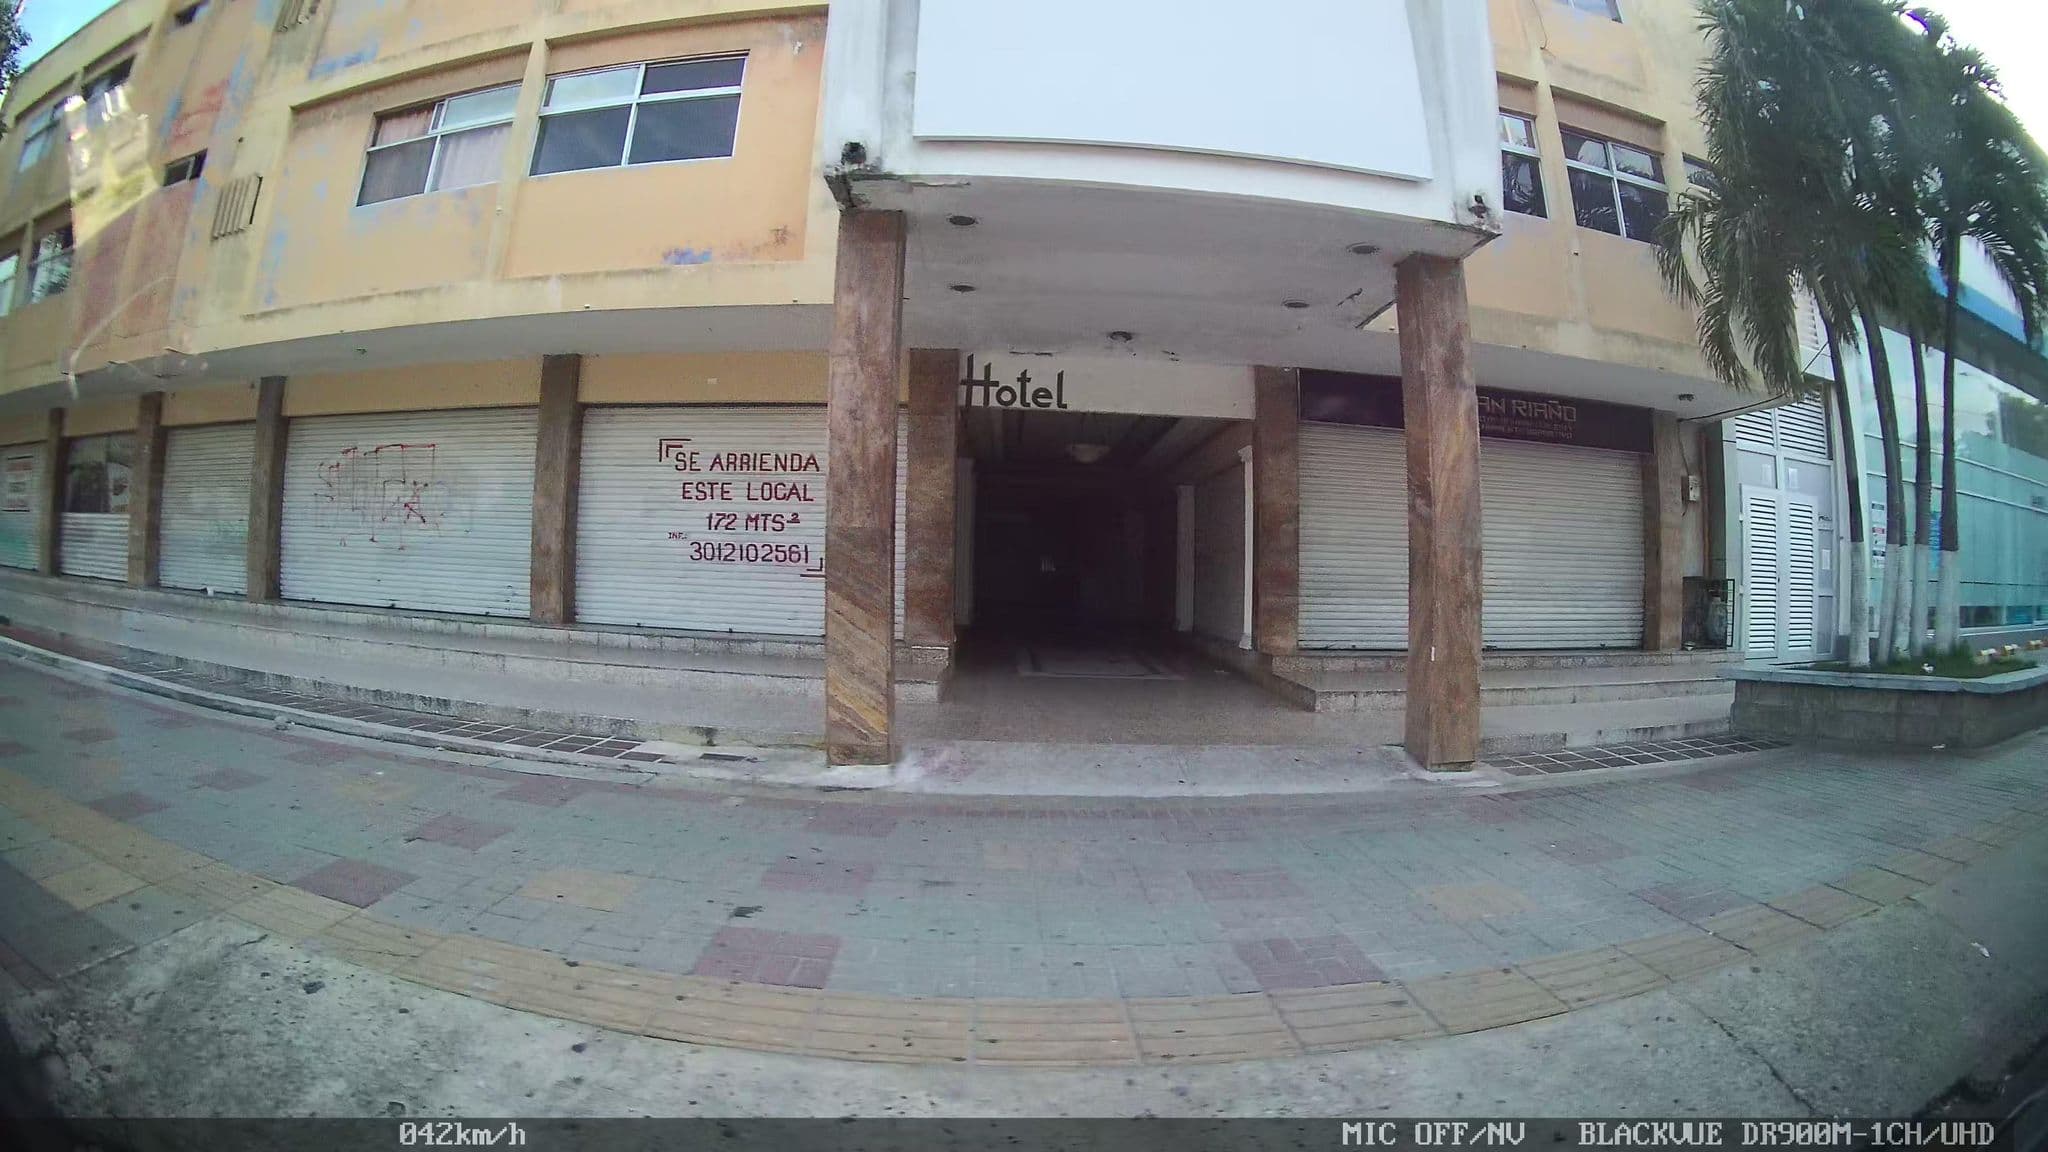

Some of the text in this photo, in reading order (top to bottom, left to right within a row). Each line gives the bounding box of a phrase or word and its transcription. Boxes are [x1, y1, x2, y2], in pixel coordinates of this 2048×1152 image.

[960, 353, 1068, 409] Hotel
[1512, 400, 1577, 422] RIAÑO
[675, 452, 820, 472] SE ARRIENDA
[682, 482, 814, 502] ESTE LOCAL
[706, 513, 736, 531] 172
[689, 541, 809, 564] 3012102561
